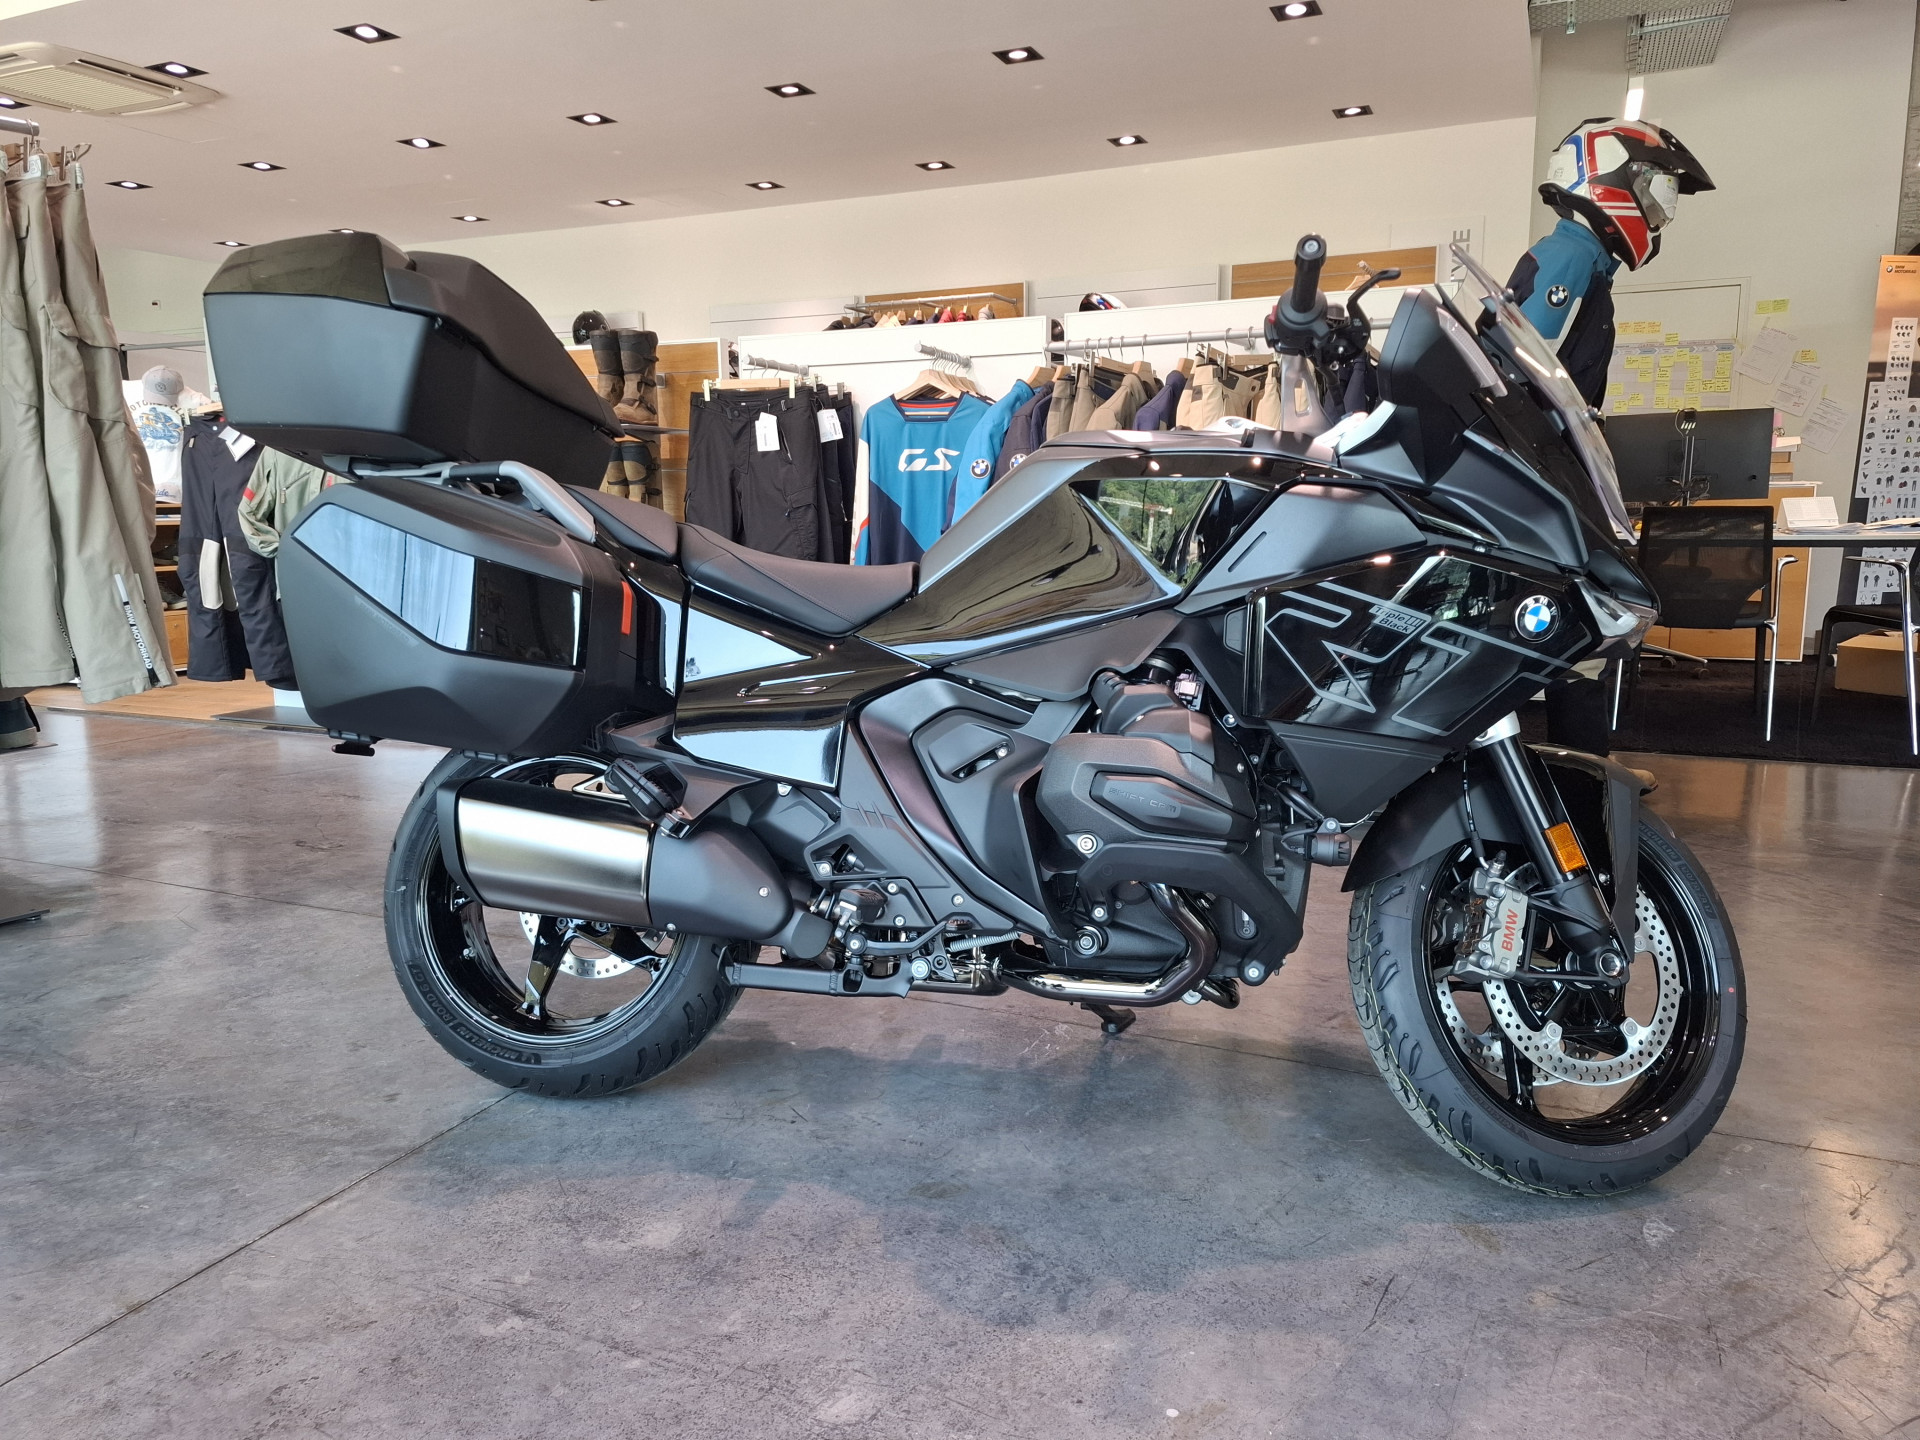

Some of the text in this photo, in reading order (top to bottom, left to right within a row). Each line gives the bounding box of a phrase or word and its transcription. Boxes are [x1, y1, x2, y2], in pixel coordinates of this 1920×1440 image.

[898, 447, 960, 472] GS
[1375, 606, 1405, 622] Triple
[1379, 617, 1410, 632] Black
[123, 604, 153, 669] BMW MOTORRAD
[1501, 908, 1519, 952] BMW
[408, 966, 425, 982] GT
[425, 993, 453, 1022] ROAD
[456, 1026, 519, 1060] MICHELIN
